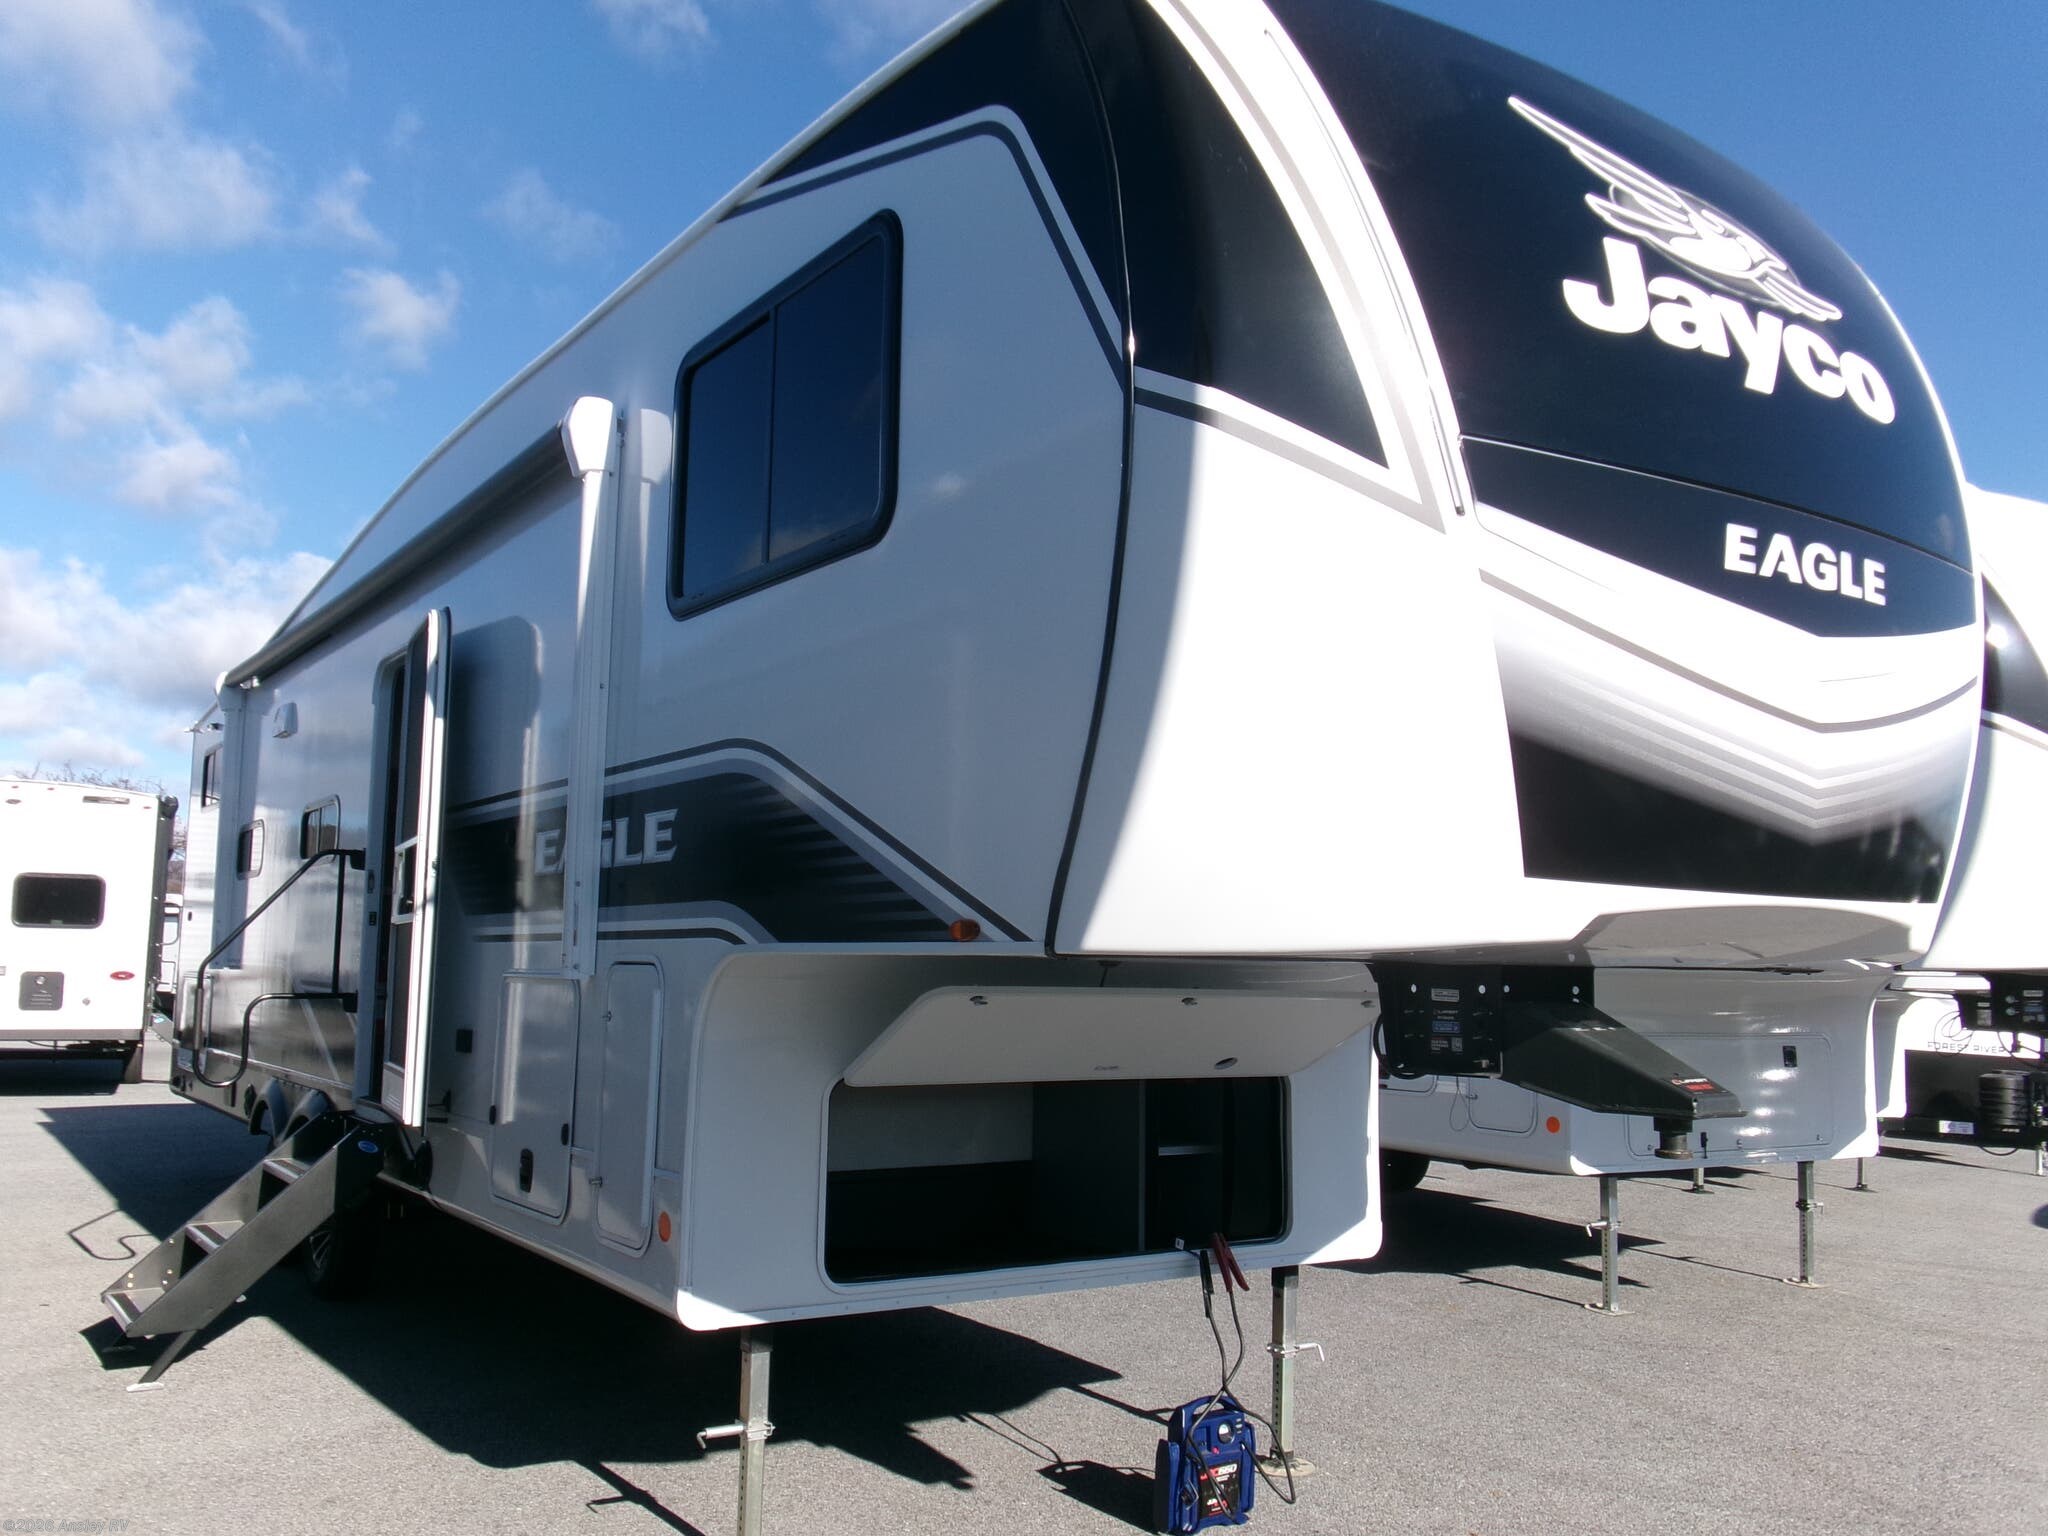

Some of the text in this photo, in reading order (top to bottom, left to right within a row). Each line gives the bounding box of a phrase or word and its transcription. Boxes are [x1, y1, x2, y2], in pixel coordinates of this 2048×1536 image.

[1563, 237, 1895, 424] Jayco
[1724, 523, 1886, 606] EAGLE
[534, 808, 678, 875] ELE
